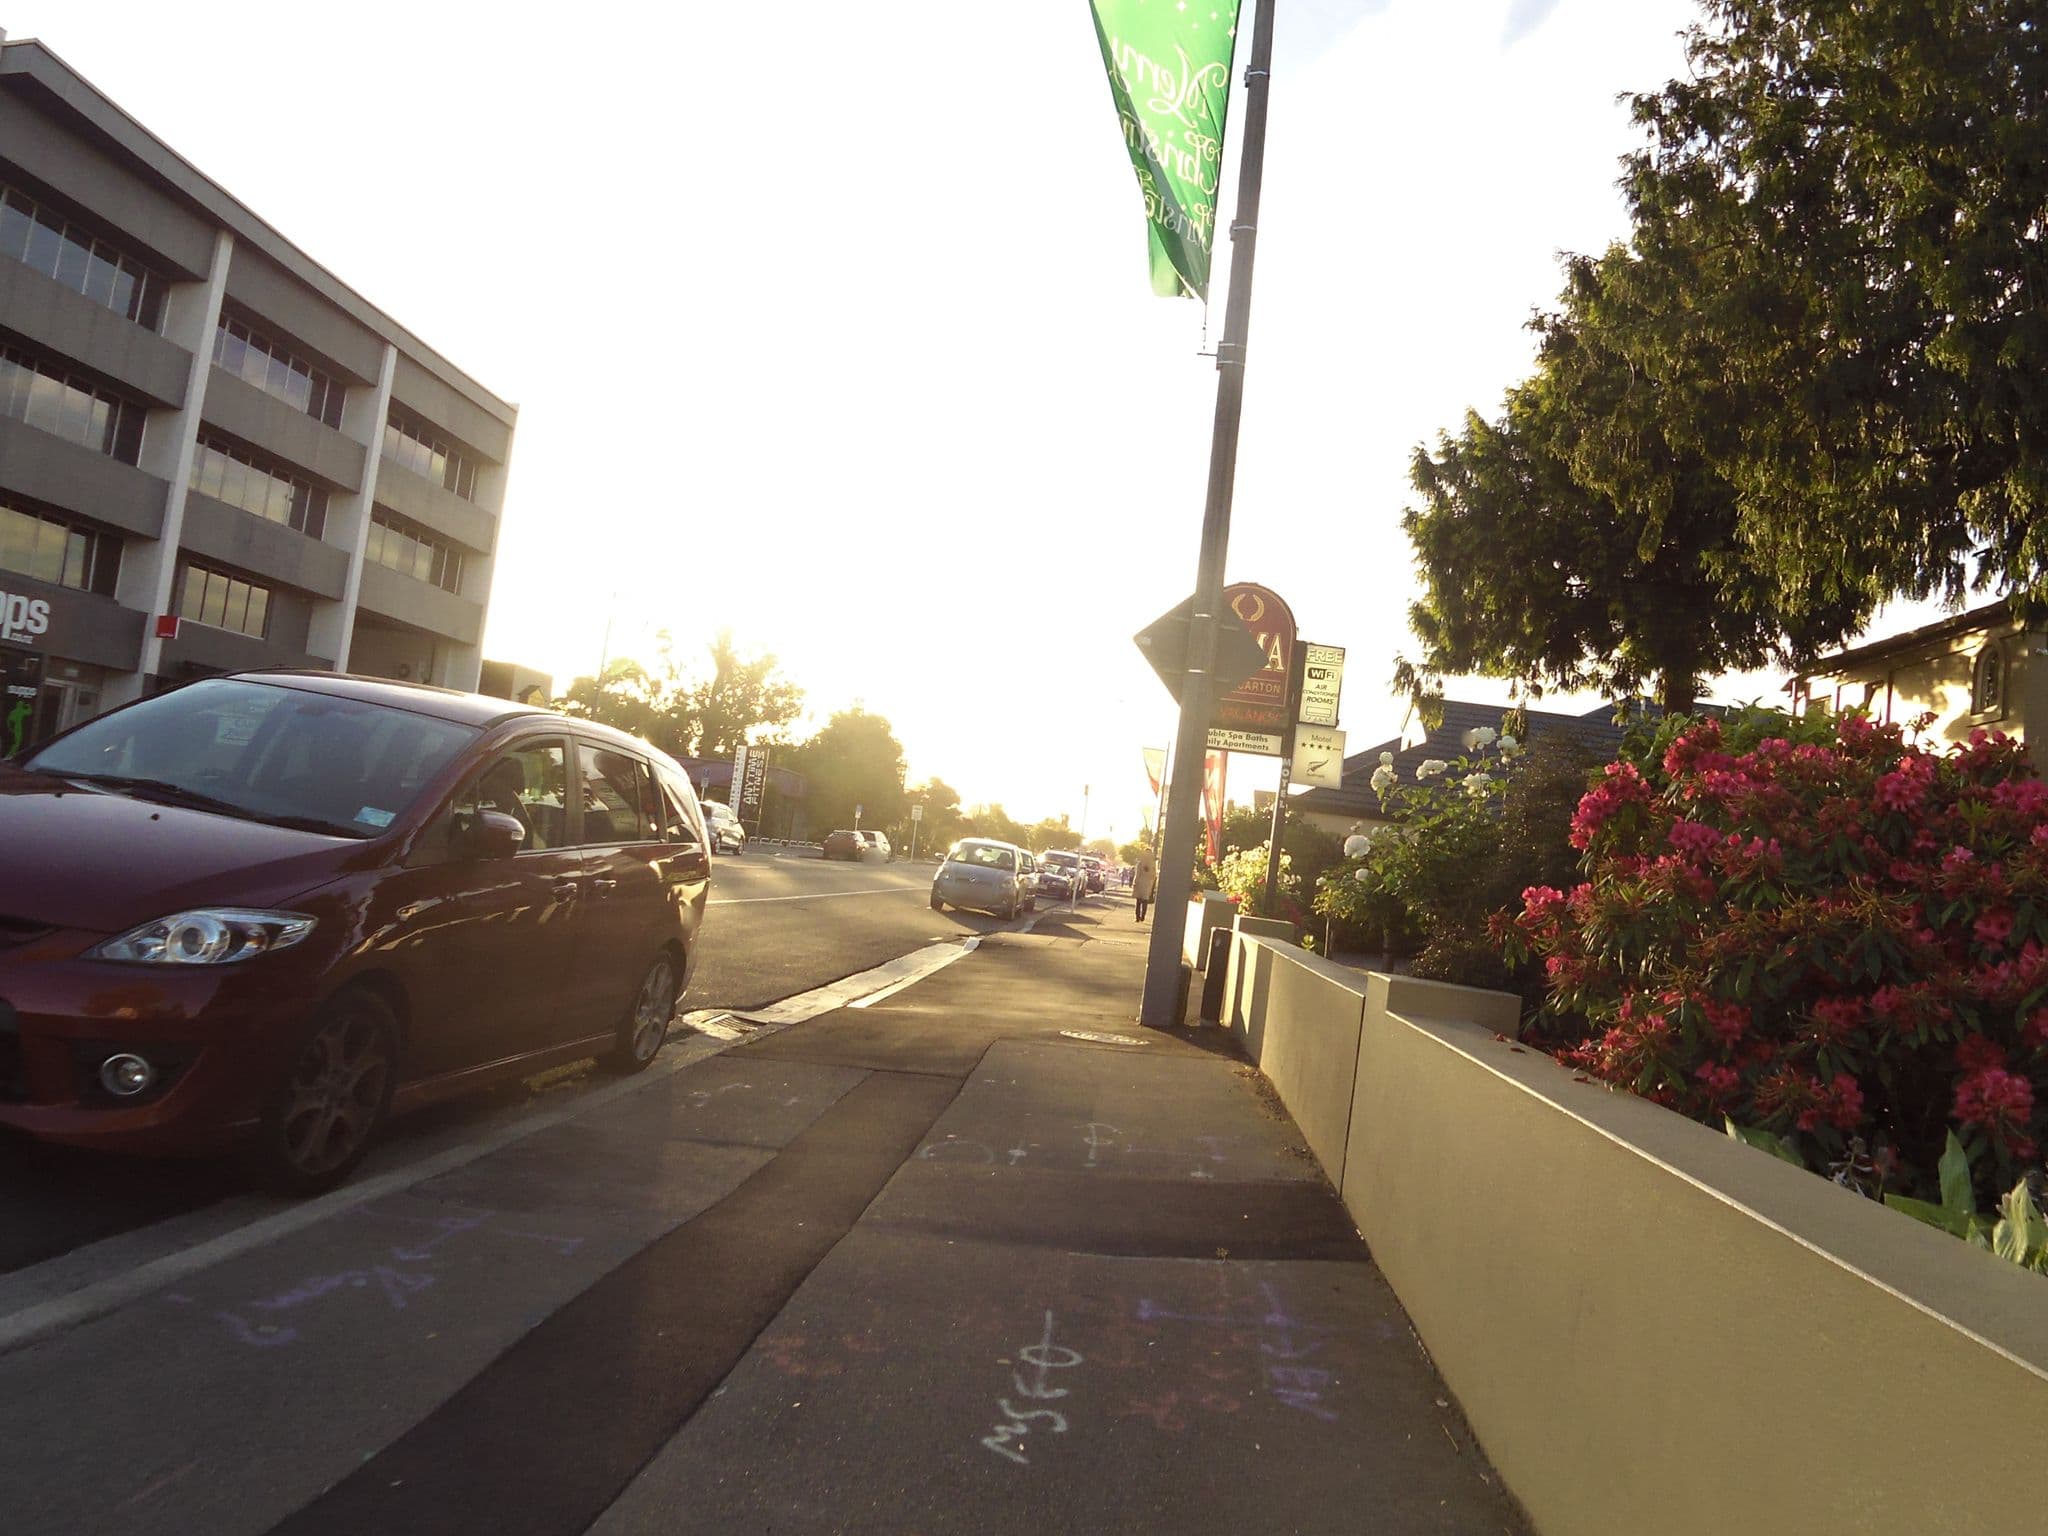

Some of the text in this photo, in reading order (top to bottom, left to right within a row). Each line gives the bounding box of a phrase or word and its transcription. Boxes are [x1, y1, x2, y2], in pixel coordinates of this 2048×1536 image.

[0, 591, 50, 642] ps
[1306, 649, 1343, 664] FREE
[1307, 696, 1335, 705] ROOMS
[1228, 731, 1243, 740] Spa
[1246, 733, 1269, 743] Baths
[1223, 739, 1270, 751] Apartments
[743, 749, 759, 805] ANYTIME
[751, 750, 765, 805] FITNESS
